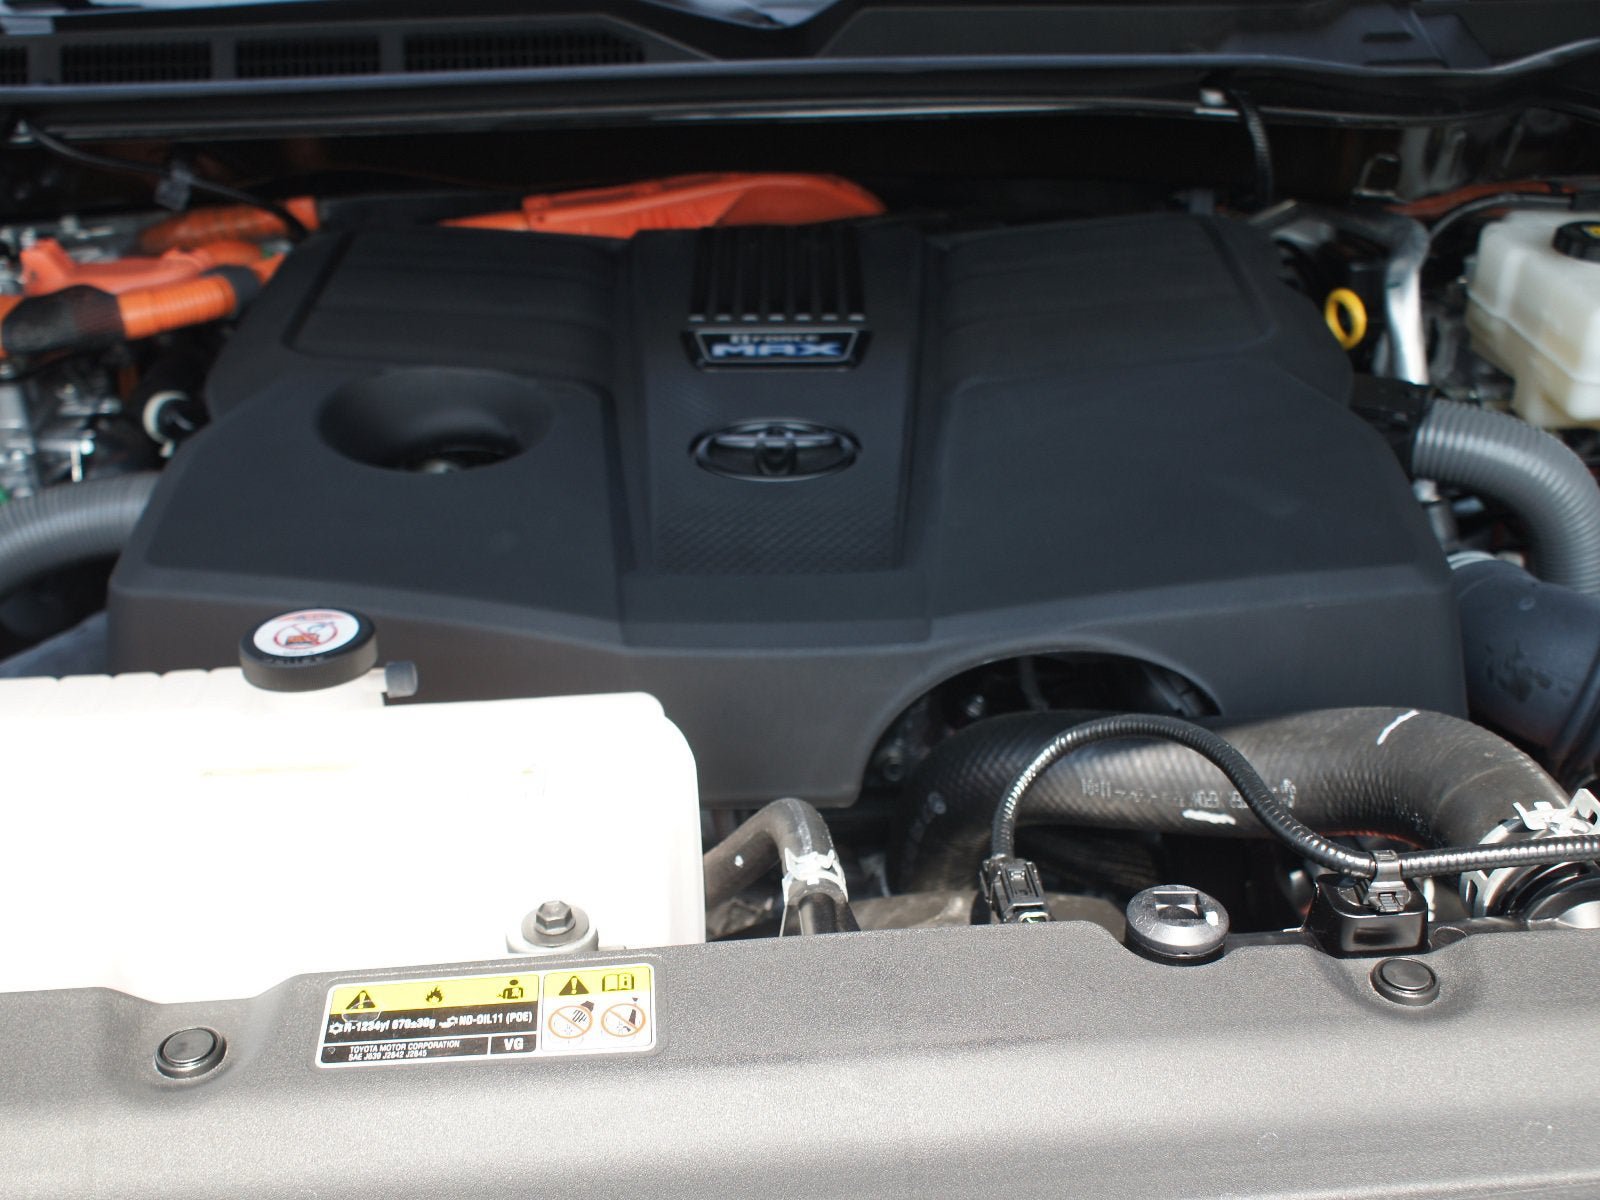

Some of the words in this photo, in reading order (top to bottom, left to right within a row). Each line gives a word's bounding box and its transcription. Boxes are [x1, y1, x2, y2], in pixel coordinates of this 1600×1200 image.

[712, 343, 840, 356] MAX
[459, 1013, 503, 1026] ND-OIL11
[505, 1011, 532, 1025] (POE)
[350, 1045, 378, 1054] TOYOTA
[380, 1043, 406, 1052] MOTOR
[407, 1040, 460, 1050] CORPORATION
[503, 1037, 524, 1050] VG
[348, 1053, 362, 1062] SAE
